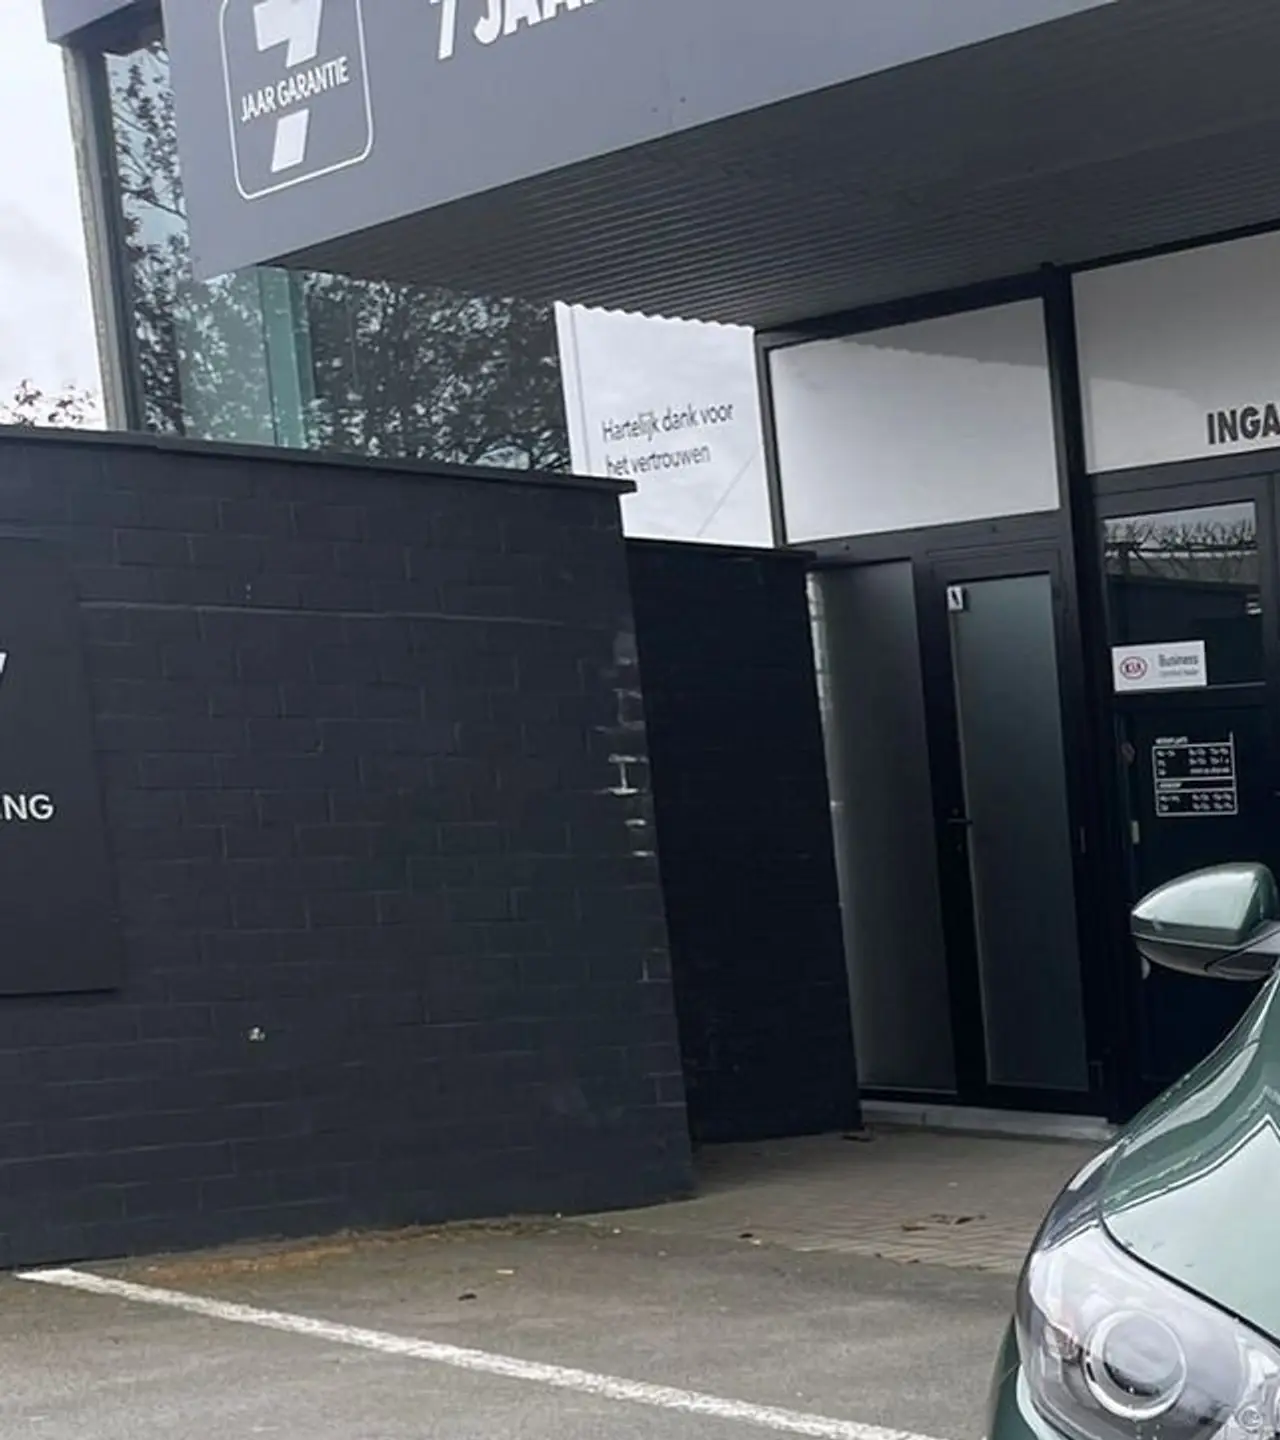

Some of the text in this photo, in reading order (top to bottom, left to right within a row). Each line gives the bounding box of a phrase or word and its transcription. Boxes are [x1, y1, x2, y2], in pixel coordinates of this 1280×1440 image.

[240, 56, 350, 122] JAAR GARANTIE
[601, 403, 734, 442] Hartelijk dank voor
[606, 445, 711, 477] het vertrouwen
[0, 794, 54, 821] NG
